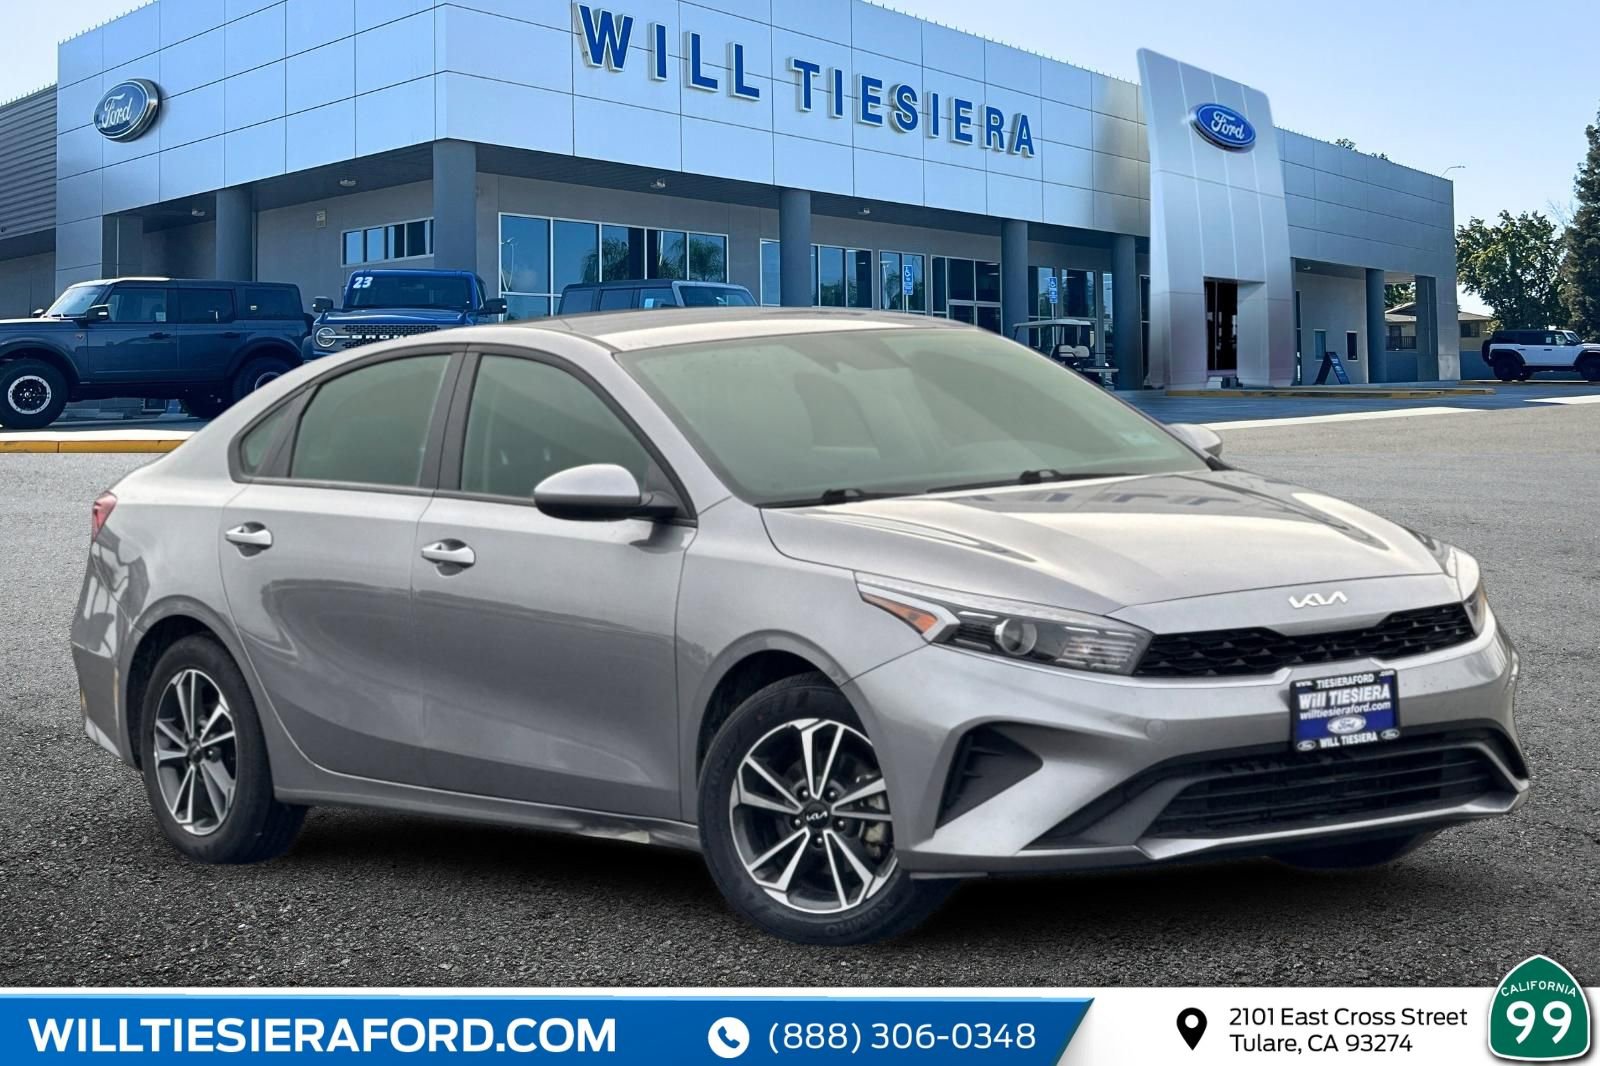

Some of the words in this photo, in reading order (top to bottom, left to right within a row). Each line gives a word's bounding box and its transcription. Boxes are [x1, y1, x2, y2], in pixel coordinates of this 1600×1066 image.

[573, 3, 760, 100] WILL
[790, 57, 1036, 158] TIESIERA
[101, 93, 133, 128] Ford
[1211, 111, 1245, 139] Ford
[352, 276, 373, 289] 23
[1289, 591, 1348, 609] KIA
[1316, 674, 1374, 689] TIESIERAFORD
[1299, 691, 1327, 710] Will
[1329, 684, 1390, 706] TIESIERA
[1300, 701, 1391, 720] willtiesieraford.com
[1320, 737, 1340, 748] WILL
[1341, 731, 1378, 746] TIESIERA
